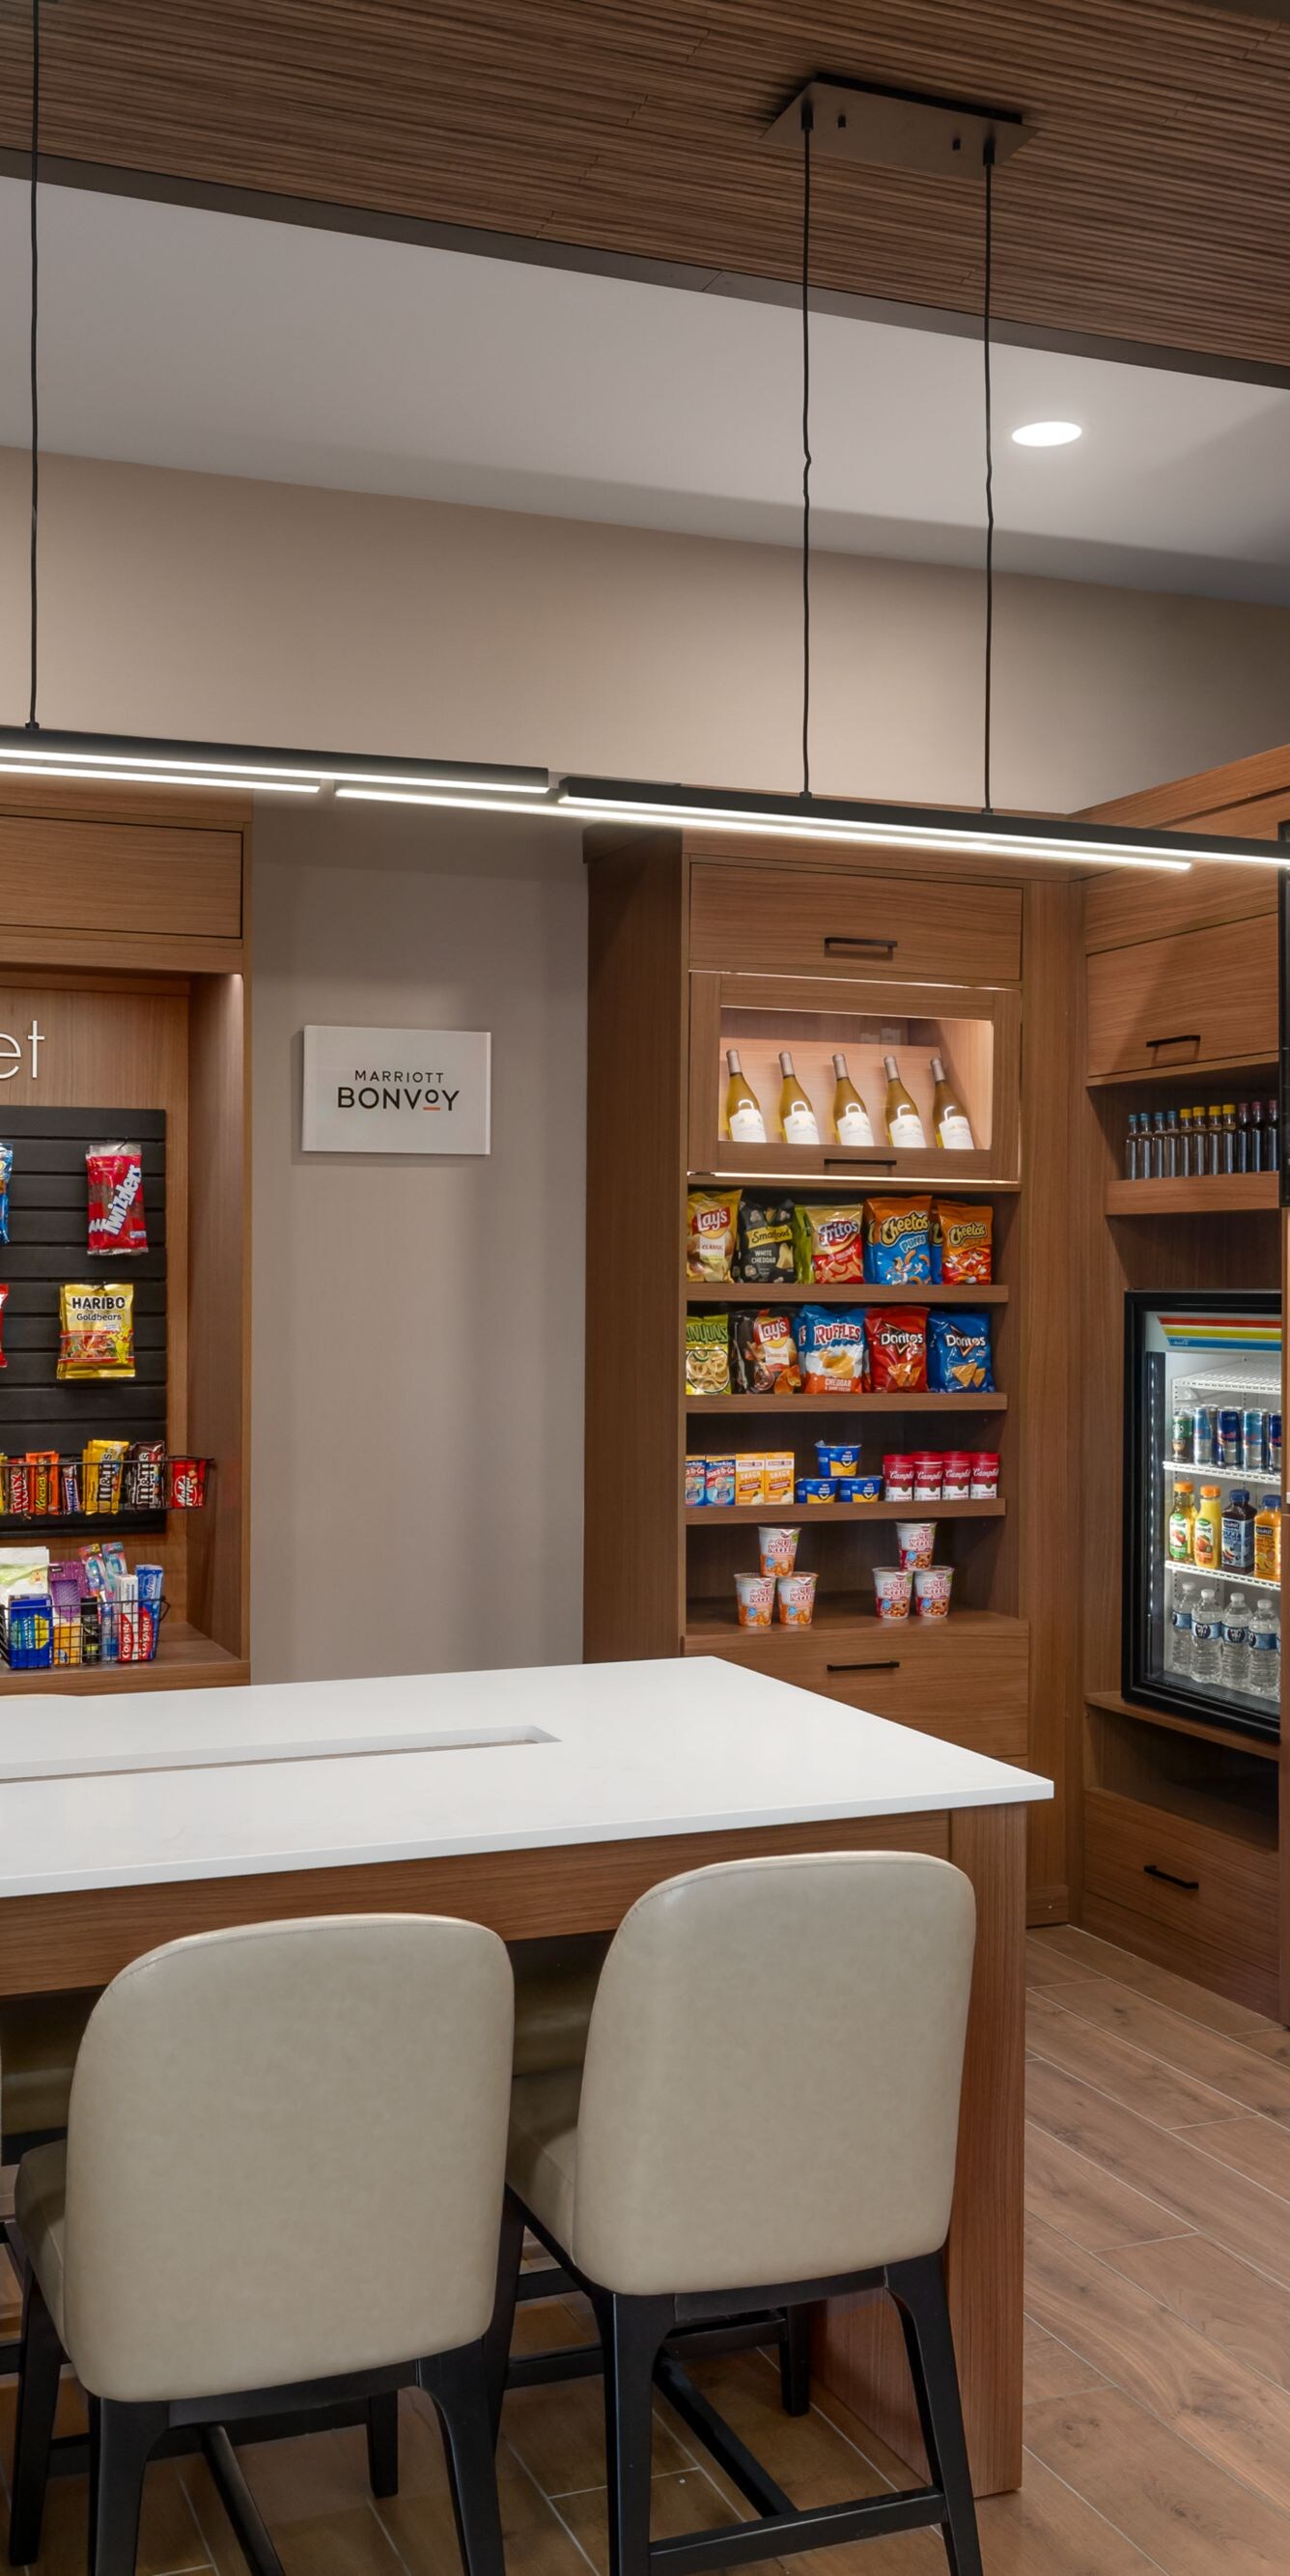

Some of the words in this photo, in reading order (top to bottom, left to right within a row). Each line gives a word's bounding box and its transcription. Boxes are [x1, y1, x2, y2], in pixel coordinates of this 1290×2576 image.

[354, 1070, 444, 1083] MARRIOTT
[338, 1087, 460, 1111] BONVOY
[697, 1209, 728, 1231] Lay's
[881, 1213, 928, 1245] Cheetos
[819, 1221, 858, 1246] Fritos
[949, 1223, 986, 1245] Cheetos
[71, 1297, 126, 1310] HARIBO
[758, 1319, 787, 1343] Lay's
[814, 1323, 862, 1345] RUFFLES
[881, 1333, 924, 1345] Doritos
[946, 1334, 986, 1346] Doritos
[122, 1621, 131, 1659] Colgate
